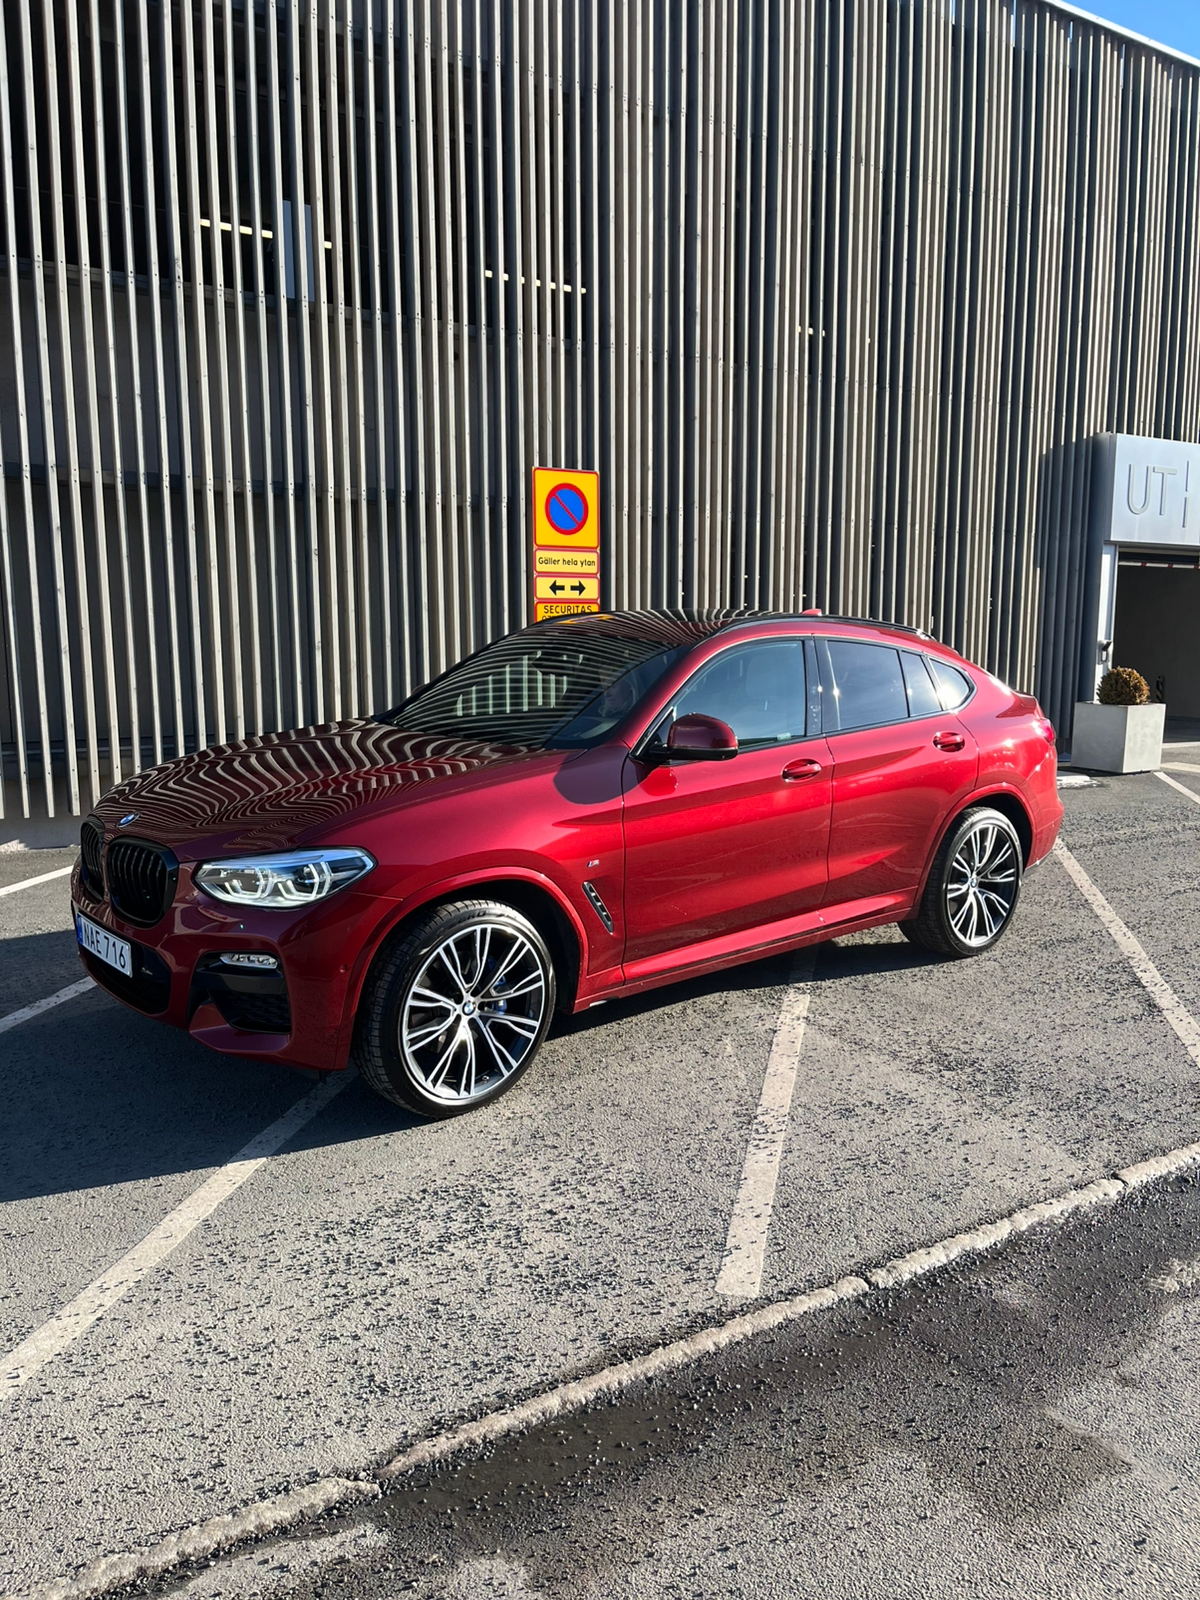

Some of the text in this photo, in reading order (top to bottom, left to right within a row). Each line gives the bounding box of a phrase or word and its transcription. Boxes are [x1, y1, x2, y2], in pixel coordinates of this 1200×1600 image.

[1127, 463, 1178, 516] UT
[538, 556, 596, 567] Gäller hela ytan
[543, 604, 592, 614] SECURITAS
[83, 922, 126, 969] NAE 716
